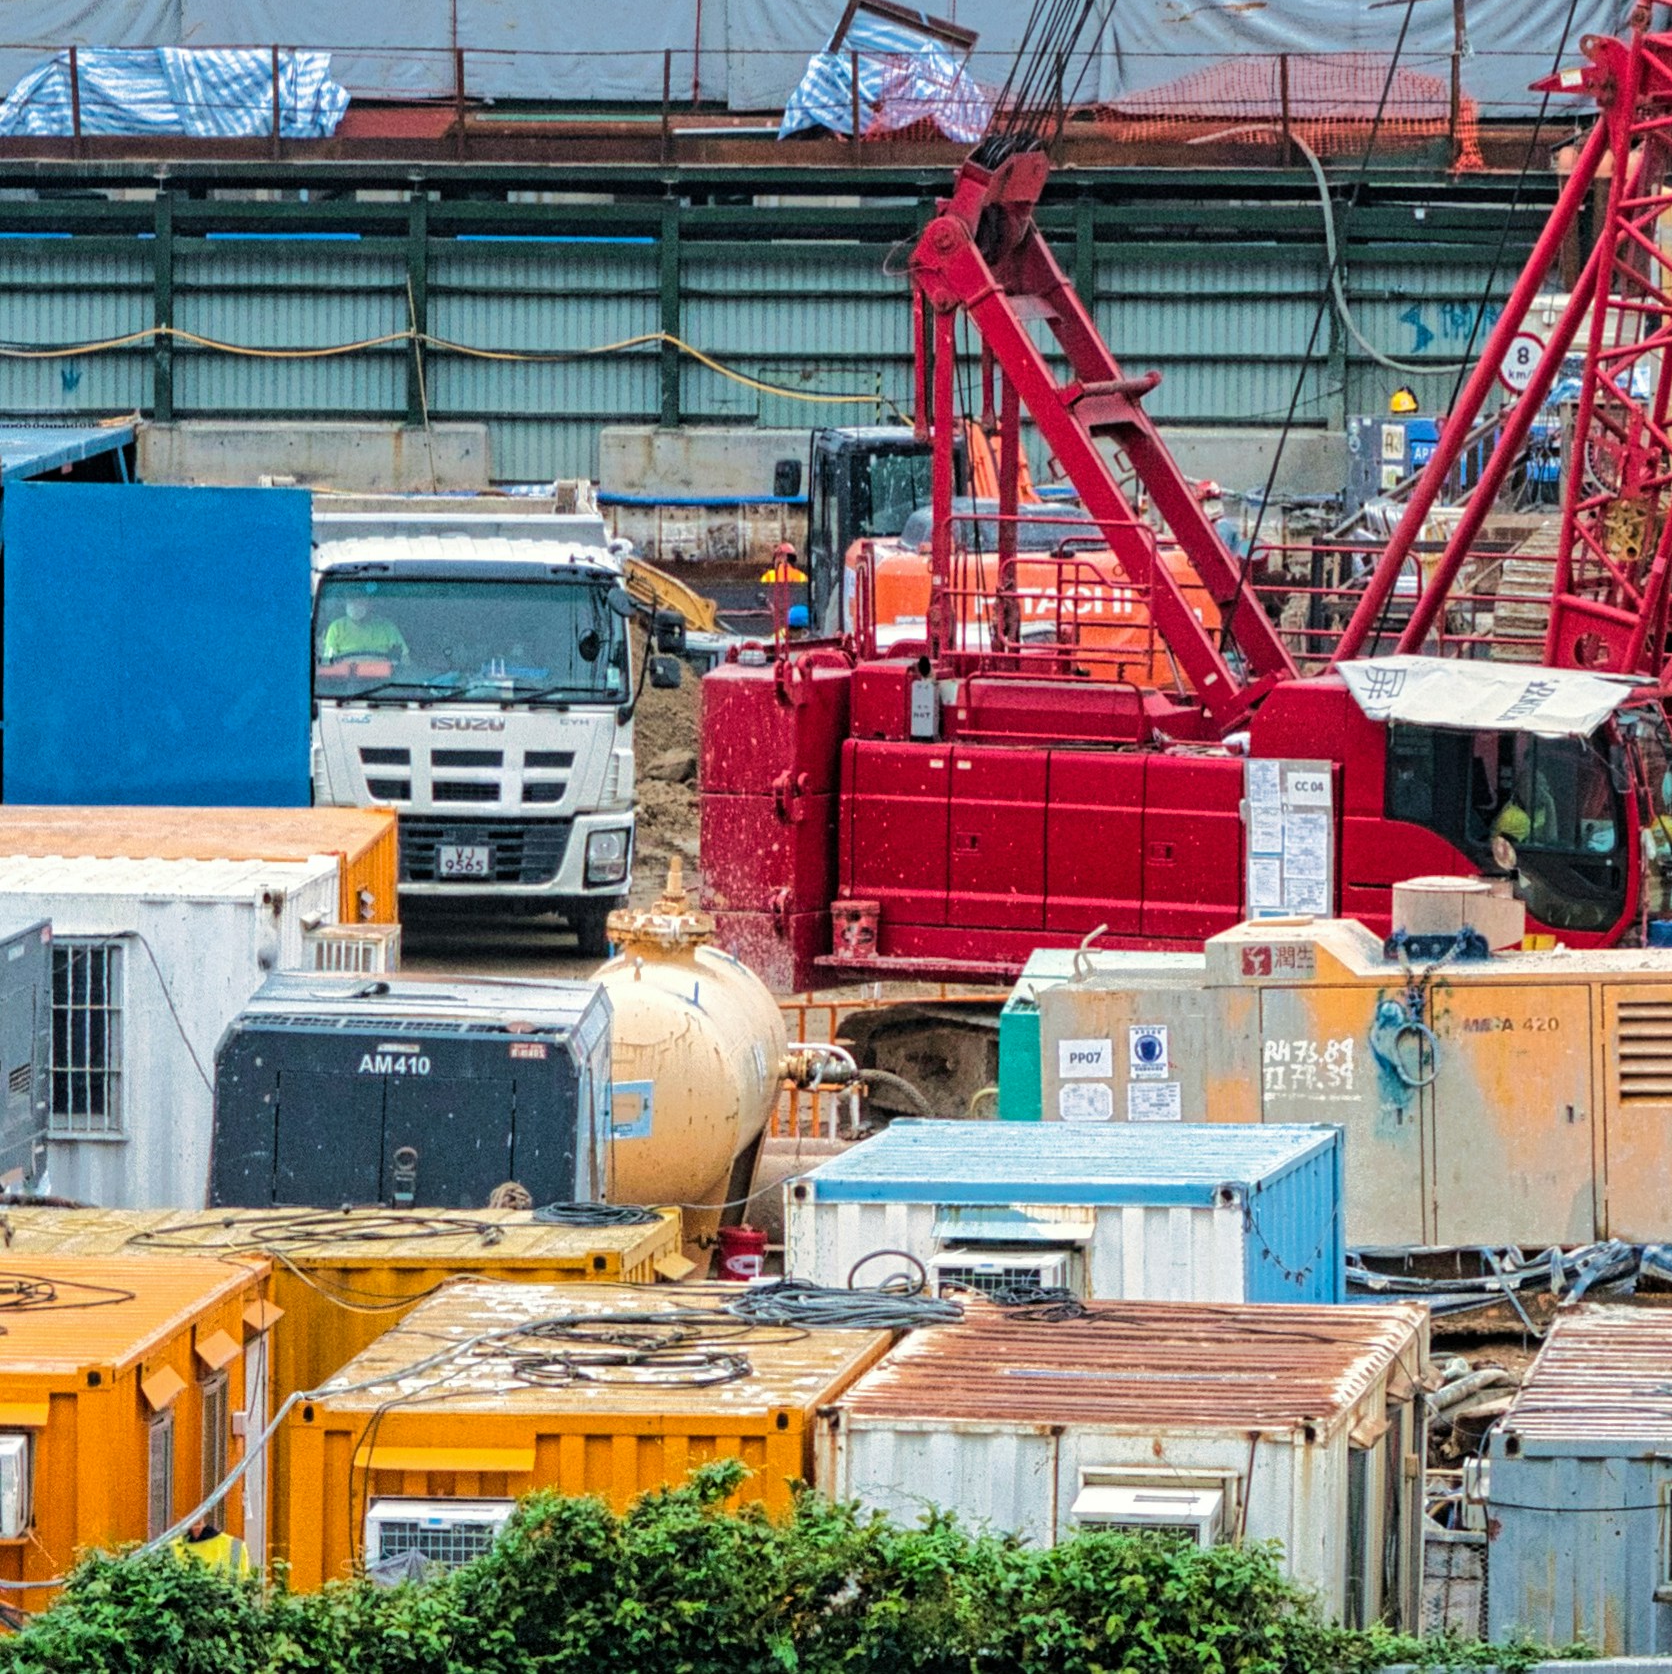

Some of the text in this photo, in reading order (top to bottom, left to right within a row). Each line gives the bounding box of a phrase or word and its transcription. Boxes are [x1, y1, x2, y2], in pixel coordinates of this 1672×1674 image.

[1517, 346, 1529, 365] 8
[1508, 368, 1537, 380] km/
[975, 587, 1132, 615] HTACHI
[430, 716, 505, 732] ISUZU
[1294, 780, 1324, 792] CC 04
[456, 848, 475, 861] VJ
[445, 859, 484, 872] 9565
[1522, 1017, 1560, 1032] 420
[358, 1054, 431, 1074] AM410
[1069, 1052, 1102, 1064] PP07
